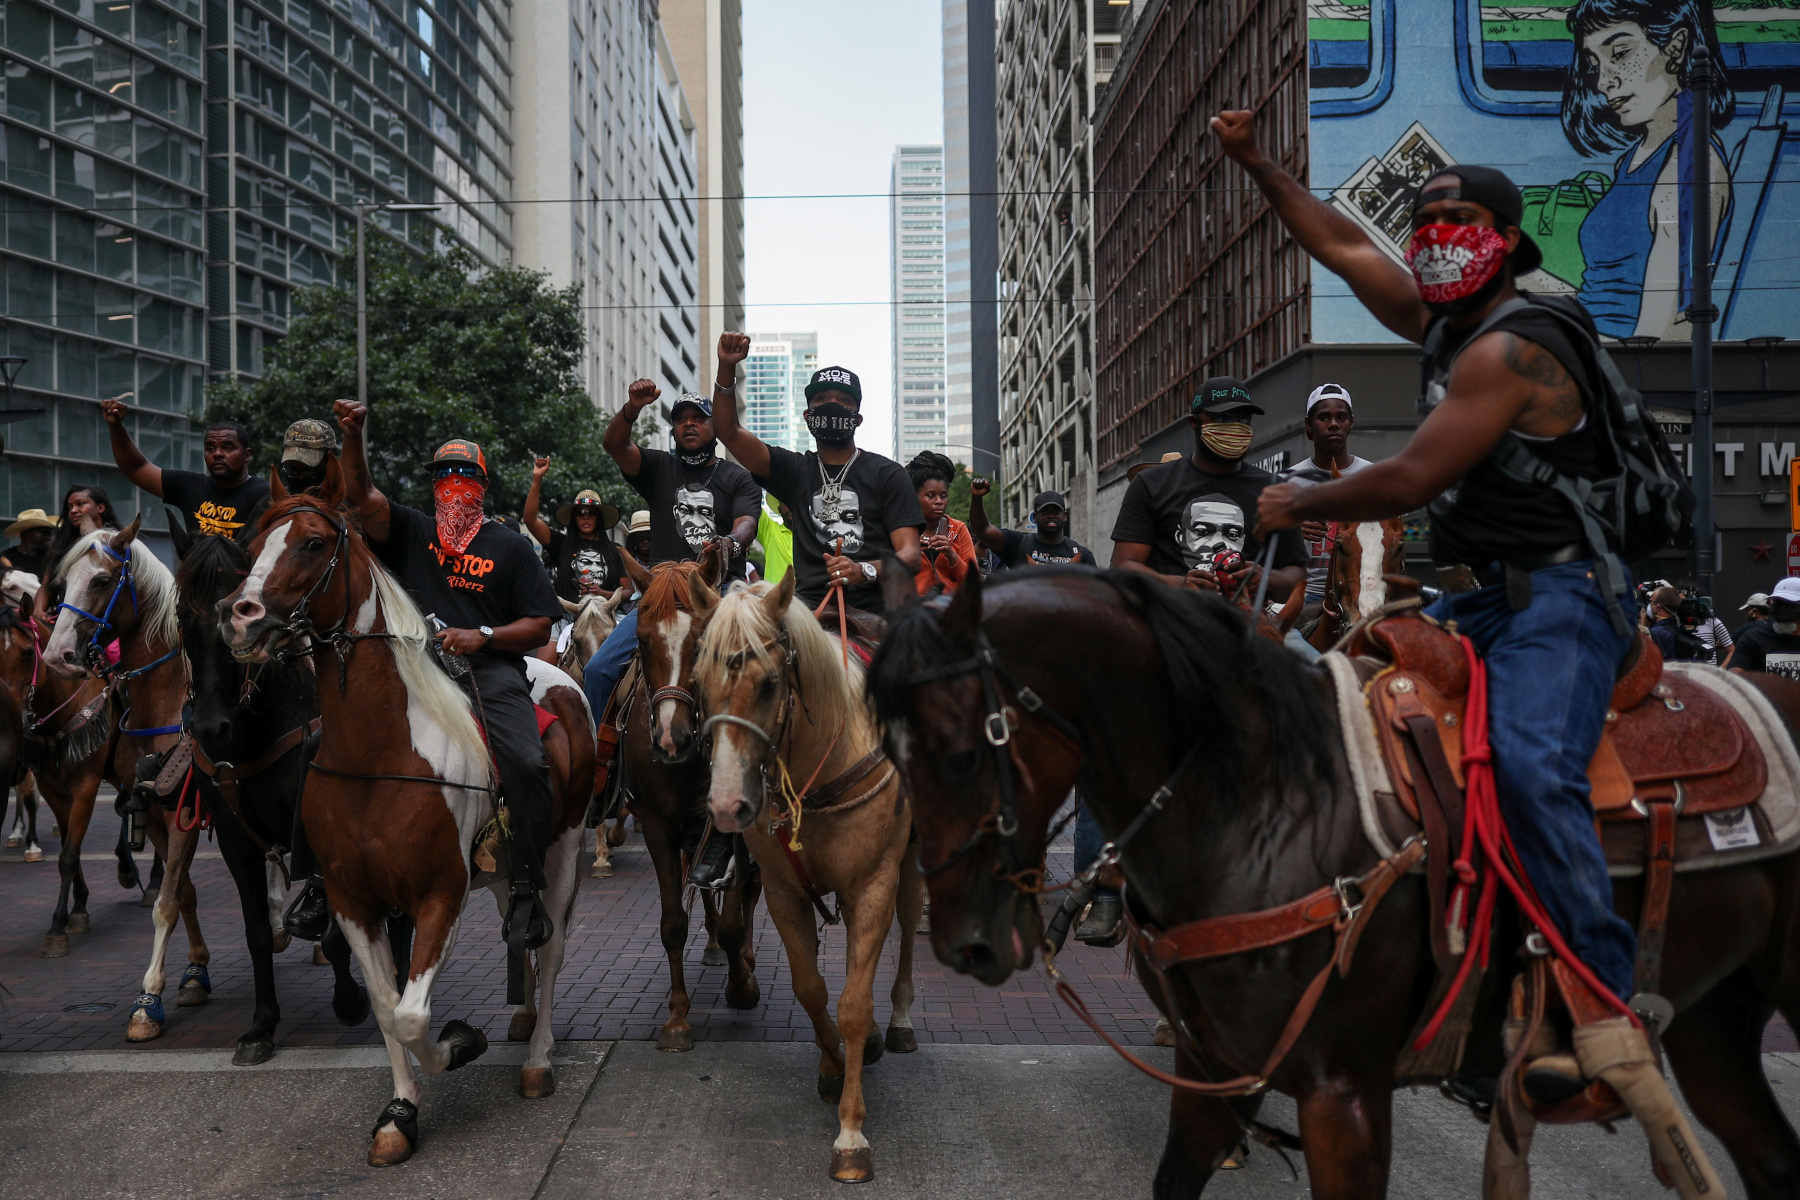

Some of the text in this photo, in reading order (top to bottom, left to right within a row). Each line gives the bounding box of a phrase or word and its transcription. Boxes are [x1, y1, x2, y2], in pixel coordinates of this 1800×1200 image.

[819, 370, 851, 381] MOB
[1212, 389, 1229, 401] Four
[831, 416, 857, 430] TIES
[1660, 423, 1683, 434] AIN
[1790, 544, 1798, 554] DO
[1200, 552, 1213, 561] I
